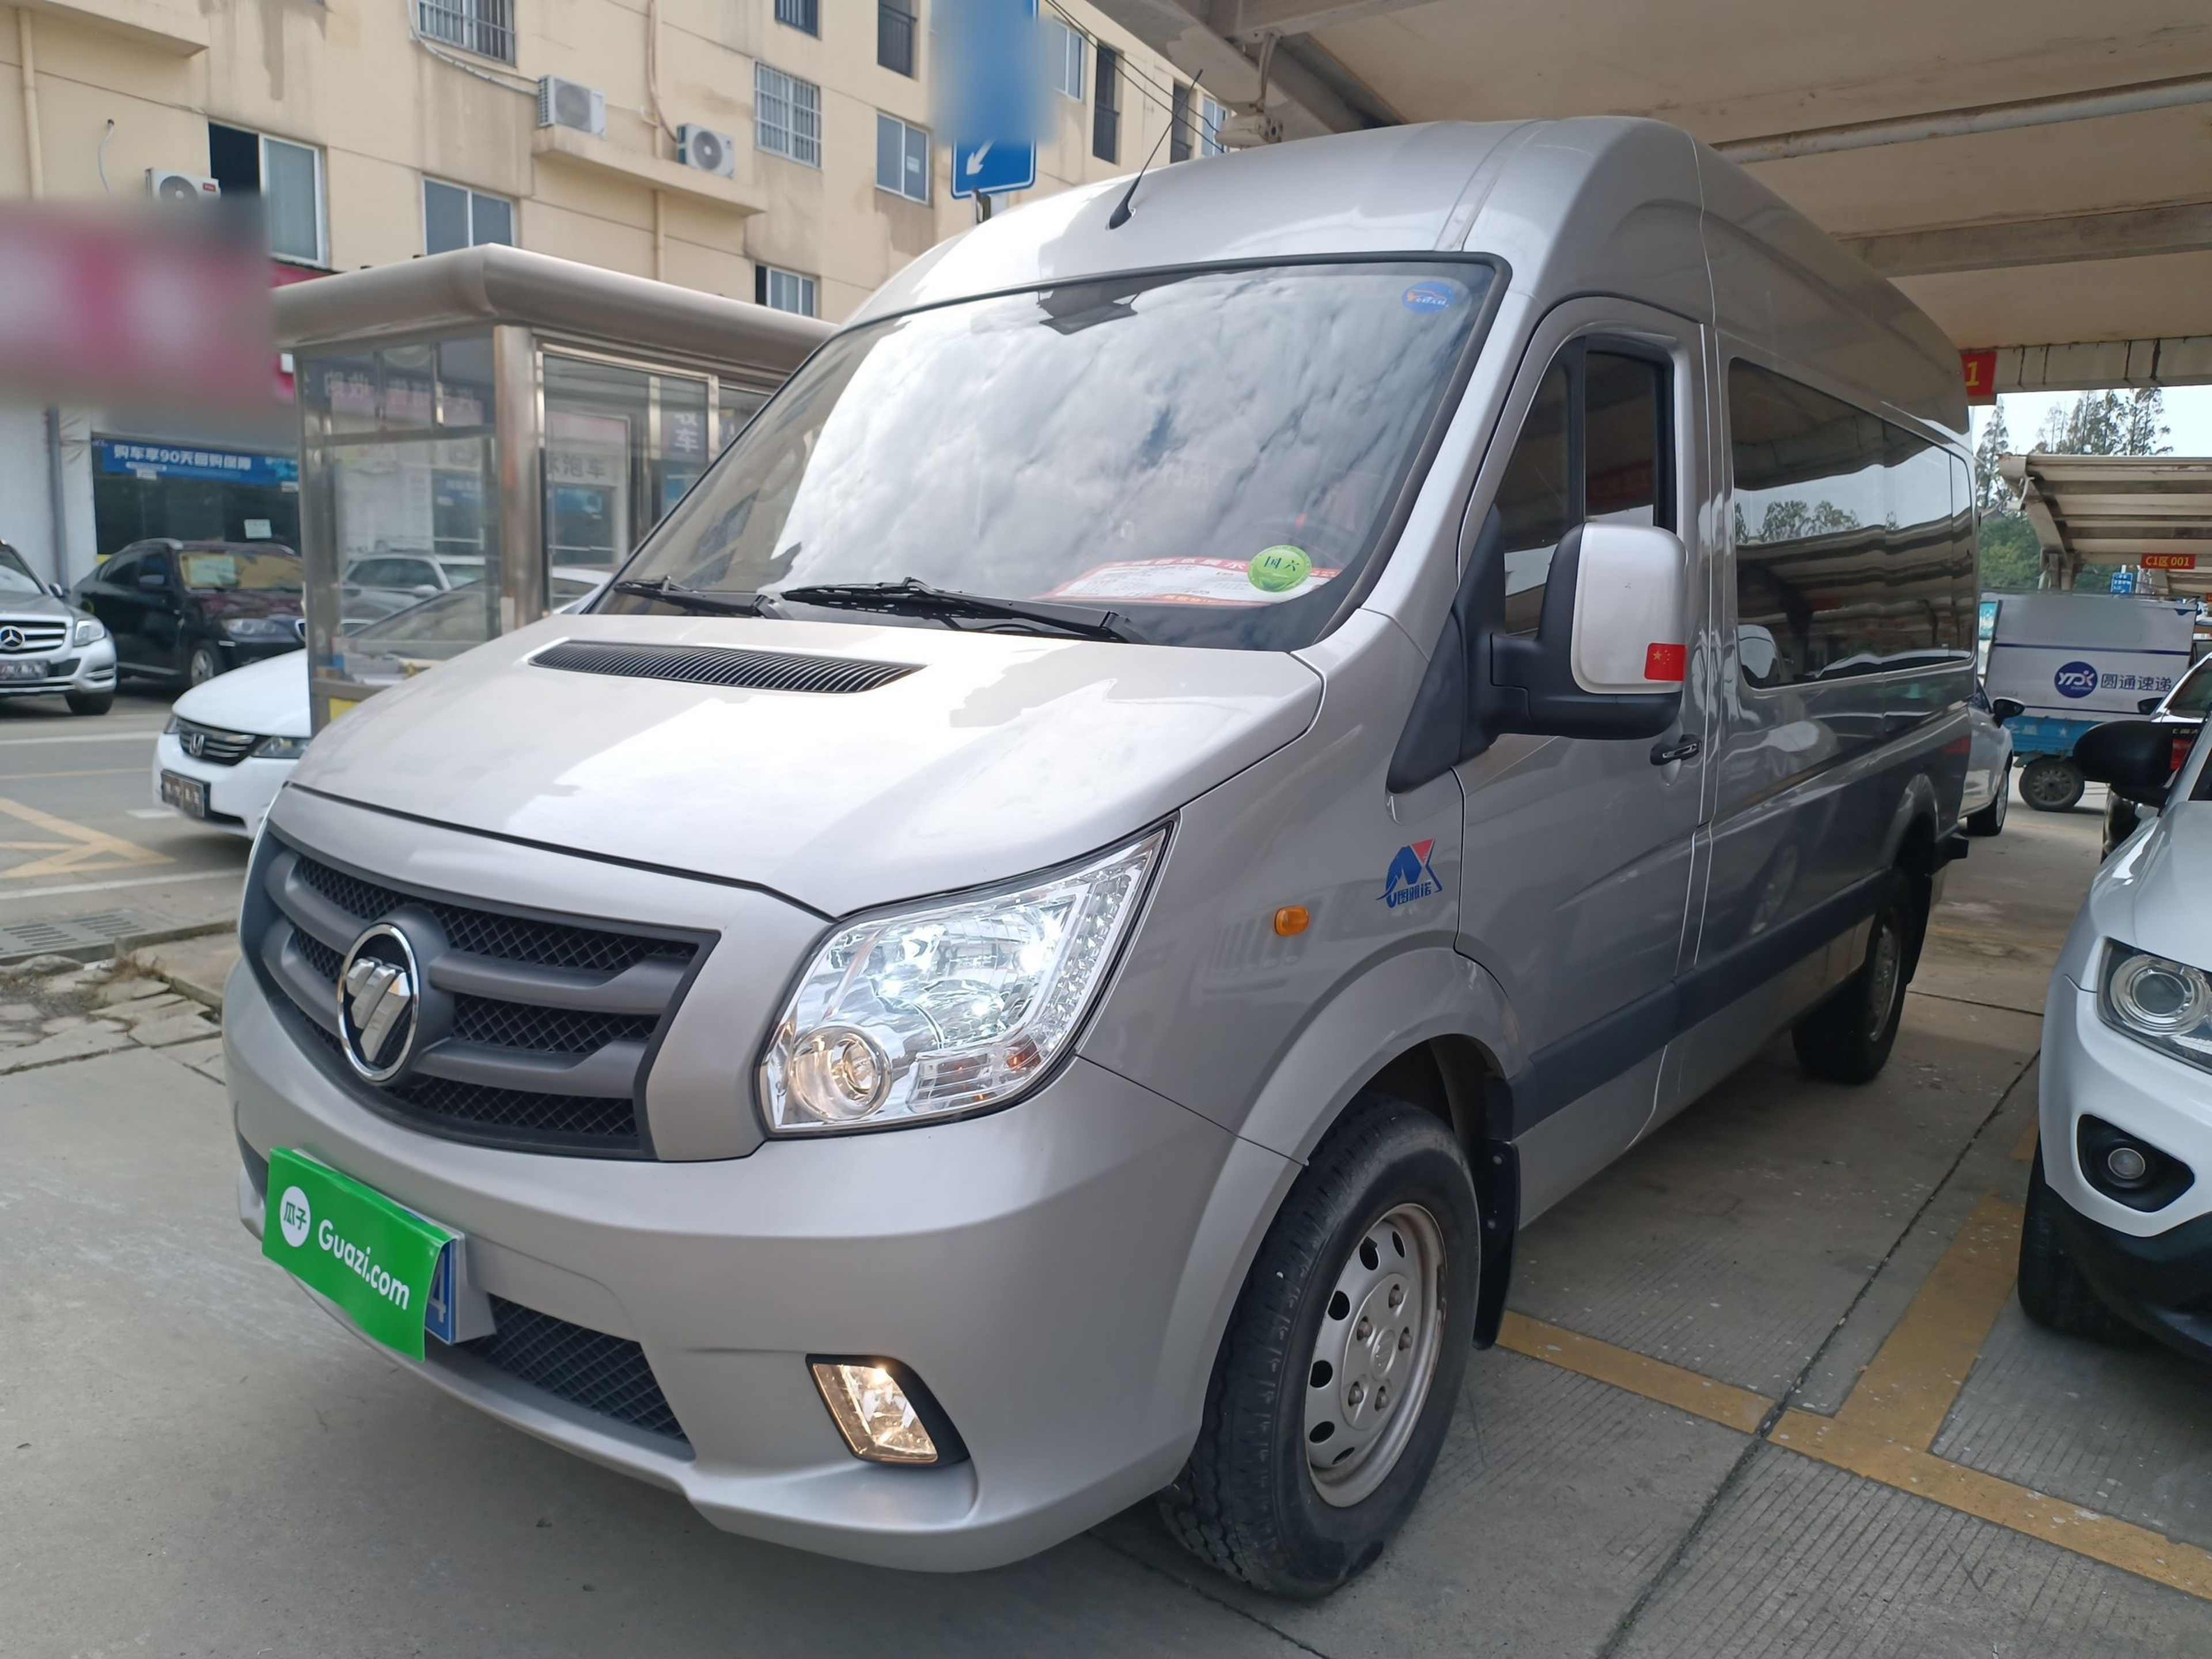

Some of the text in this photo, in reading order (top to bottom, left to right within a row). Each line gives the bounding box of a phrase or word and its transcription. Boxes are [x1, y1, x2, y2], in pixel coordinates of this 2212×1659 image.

[2170, 556, 2190, 567] 001
[2100, 673, 2172, 692] 圆通速递
[283, 1200, 308, 1232] 瓜子
[318, 1218, 411, 1311] Guazi.com
